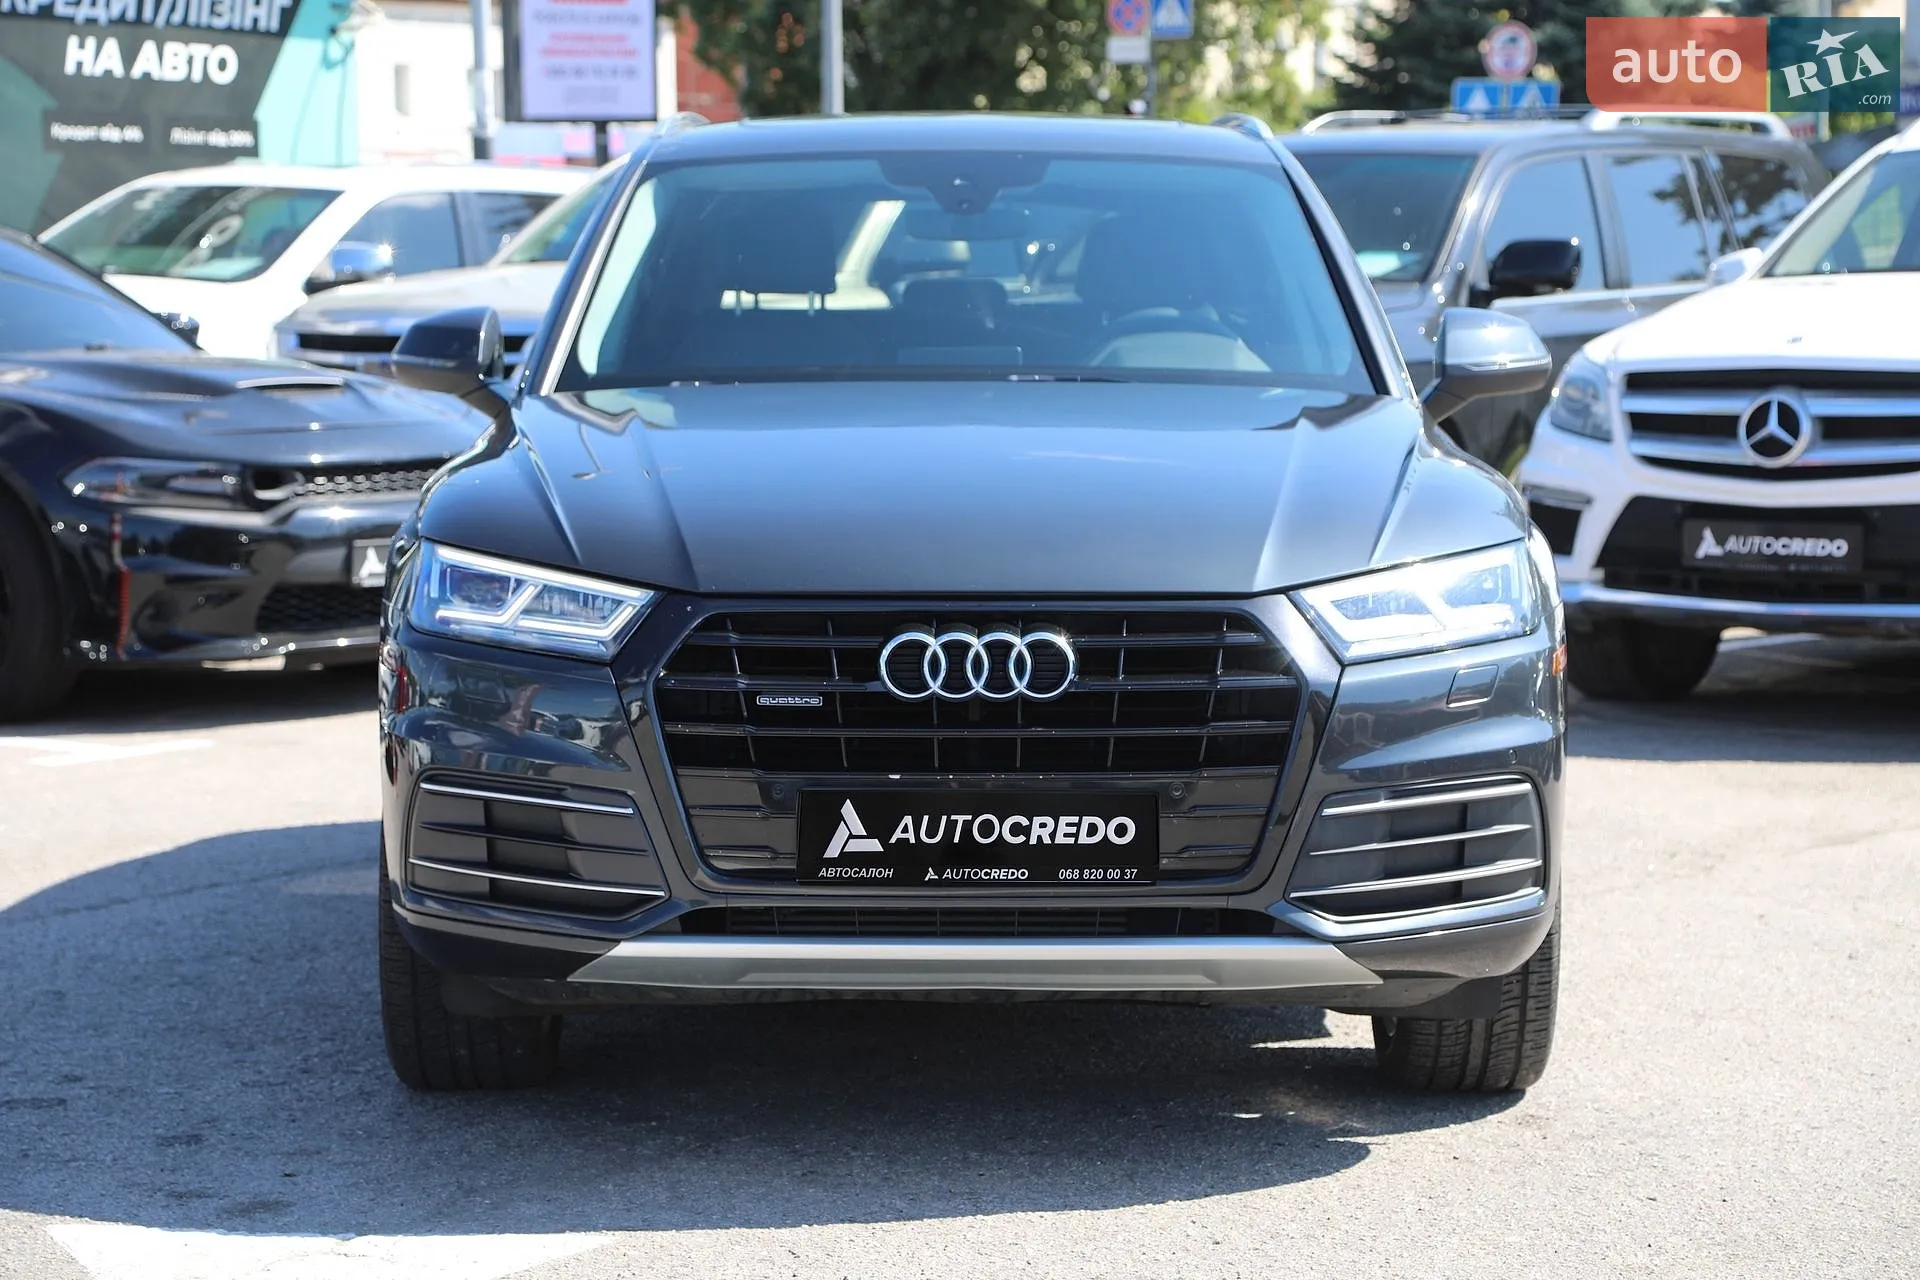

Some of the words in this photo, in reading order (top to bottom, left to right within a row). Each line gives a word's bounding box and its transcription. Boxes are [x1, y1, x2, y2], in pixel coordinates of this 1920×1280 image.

[64, 34, 125, 78] НА
[130, 39, 239, 85] АВТО
[1724, 534, 1849, 558] AUTOCREDO
[760, 697, 820, 705] quattro
[888, 813, 1136, 845] AUTOCREDO
[818, 867, 894, 879] АВТОСАЛОН
[942, 868, 1029, 880] AUTOCREDO
[1058, 868, 1081, 880] 068
[1083, 868, 1104, 880] 820
[1106, 868, 1122, 880] 00
[1123, 868, 1138, 880] 37
